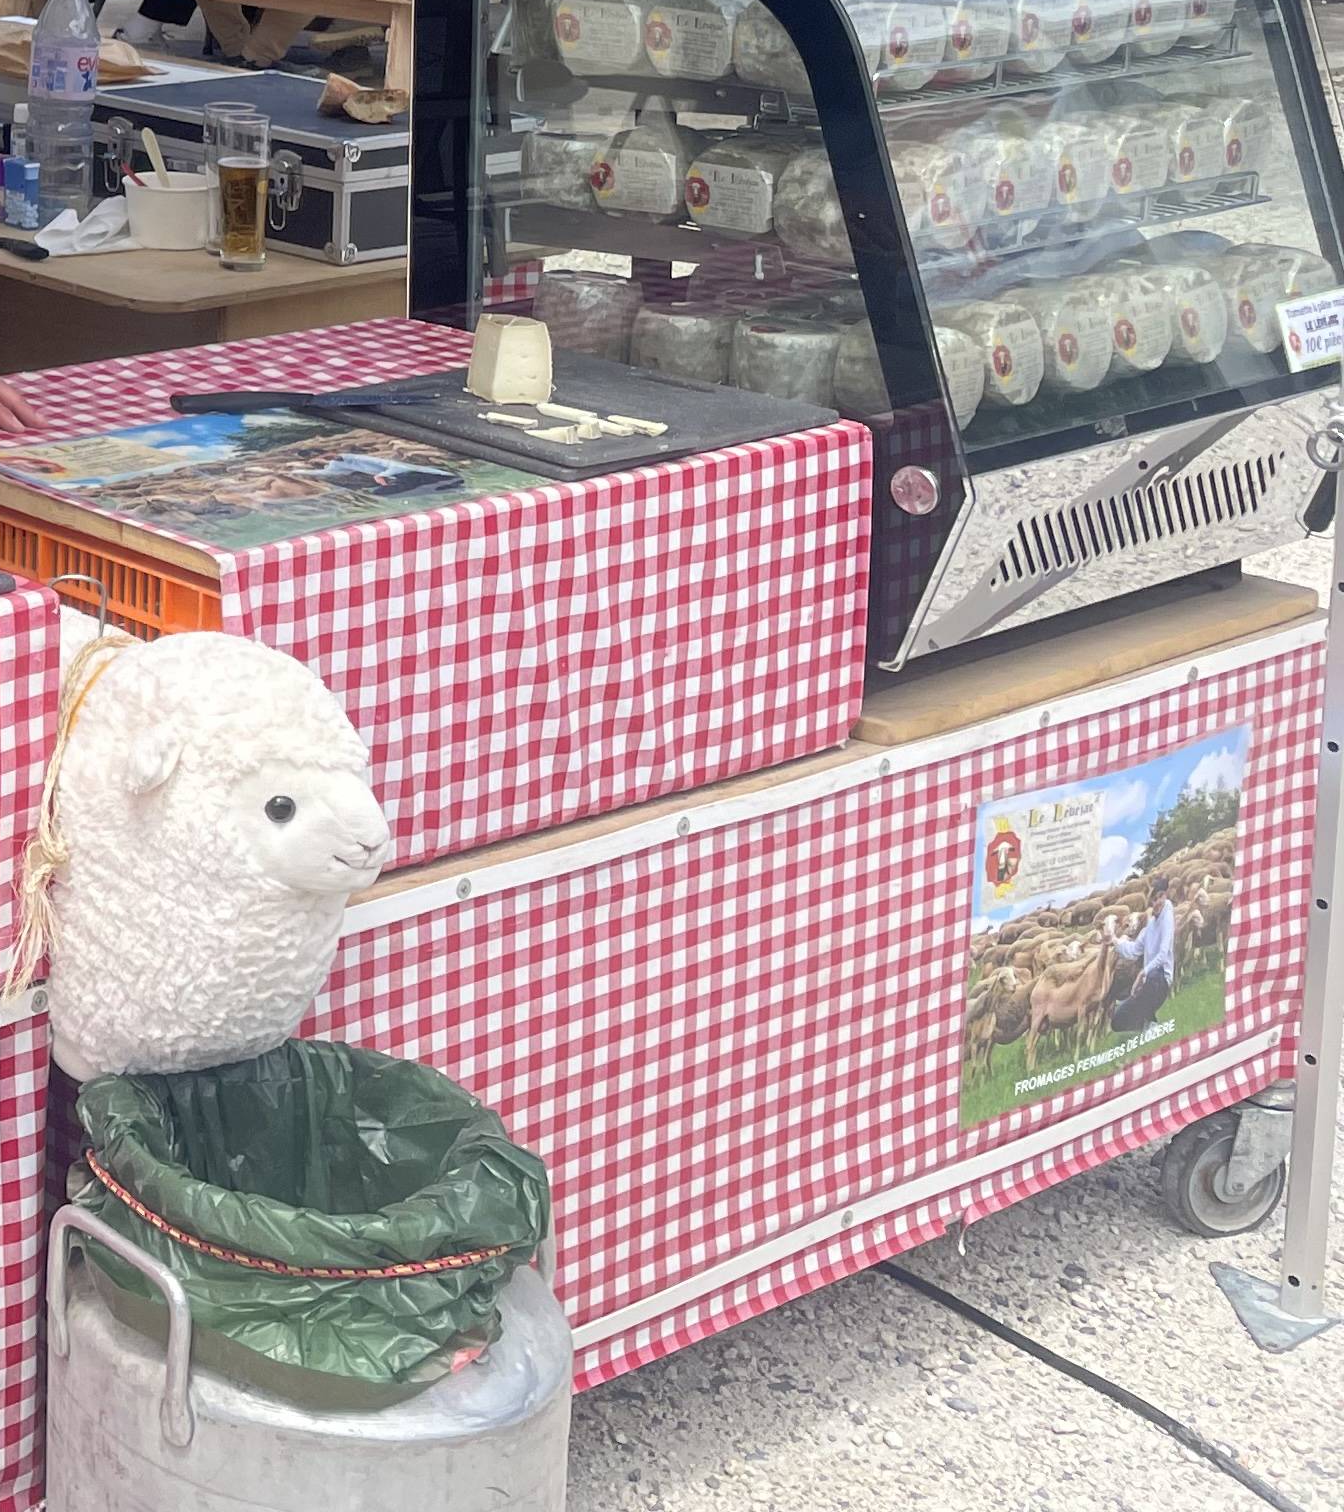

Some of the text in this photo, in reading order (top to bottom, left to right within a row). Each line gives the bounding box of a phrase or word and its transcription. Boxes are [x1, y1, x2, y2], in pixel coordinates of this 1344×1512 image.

[1014, 1063, 1076, 1097] FROMAGES
[1075, 1042, 1127, 1075] FERMIERS
[1127, 1034, 1140, 1054] DE
